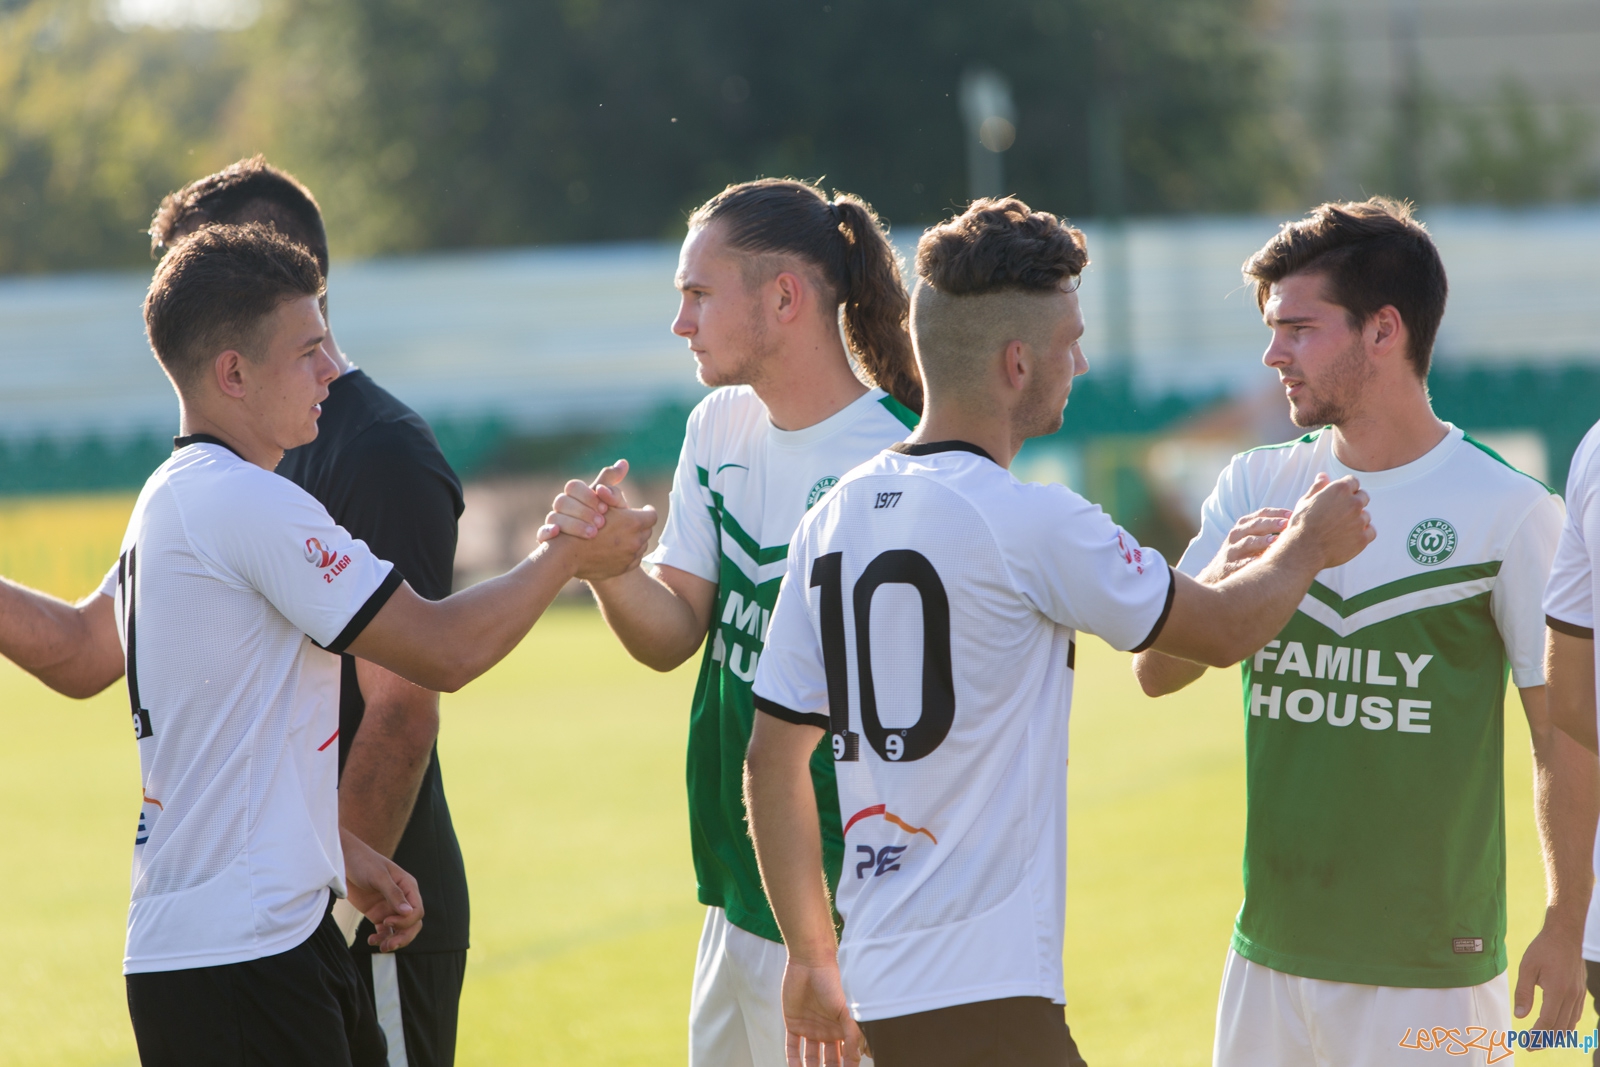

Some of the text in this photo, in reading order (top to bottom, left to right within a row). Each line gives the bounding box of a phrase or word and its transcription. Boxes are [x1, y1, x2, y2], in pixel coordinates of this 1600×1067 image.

[808, 479, 829, 505] WARTA
[873, 491, 903, 510] 1977
[1410, 521, 1434, 547] WARTA
[323, 554, 352, 584] 2 LIGA
[1416, 554, 1439, 563] 1912
[809, 549, 956, 762] 10
[1253, 639, 1434, 688] FAMILY
[1250, 682, 1432, 734] HOUSE
